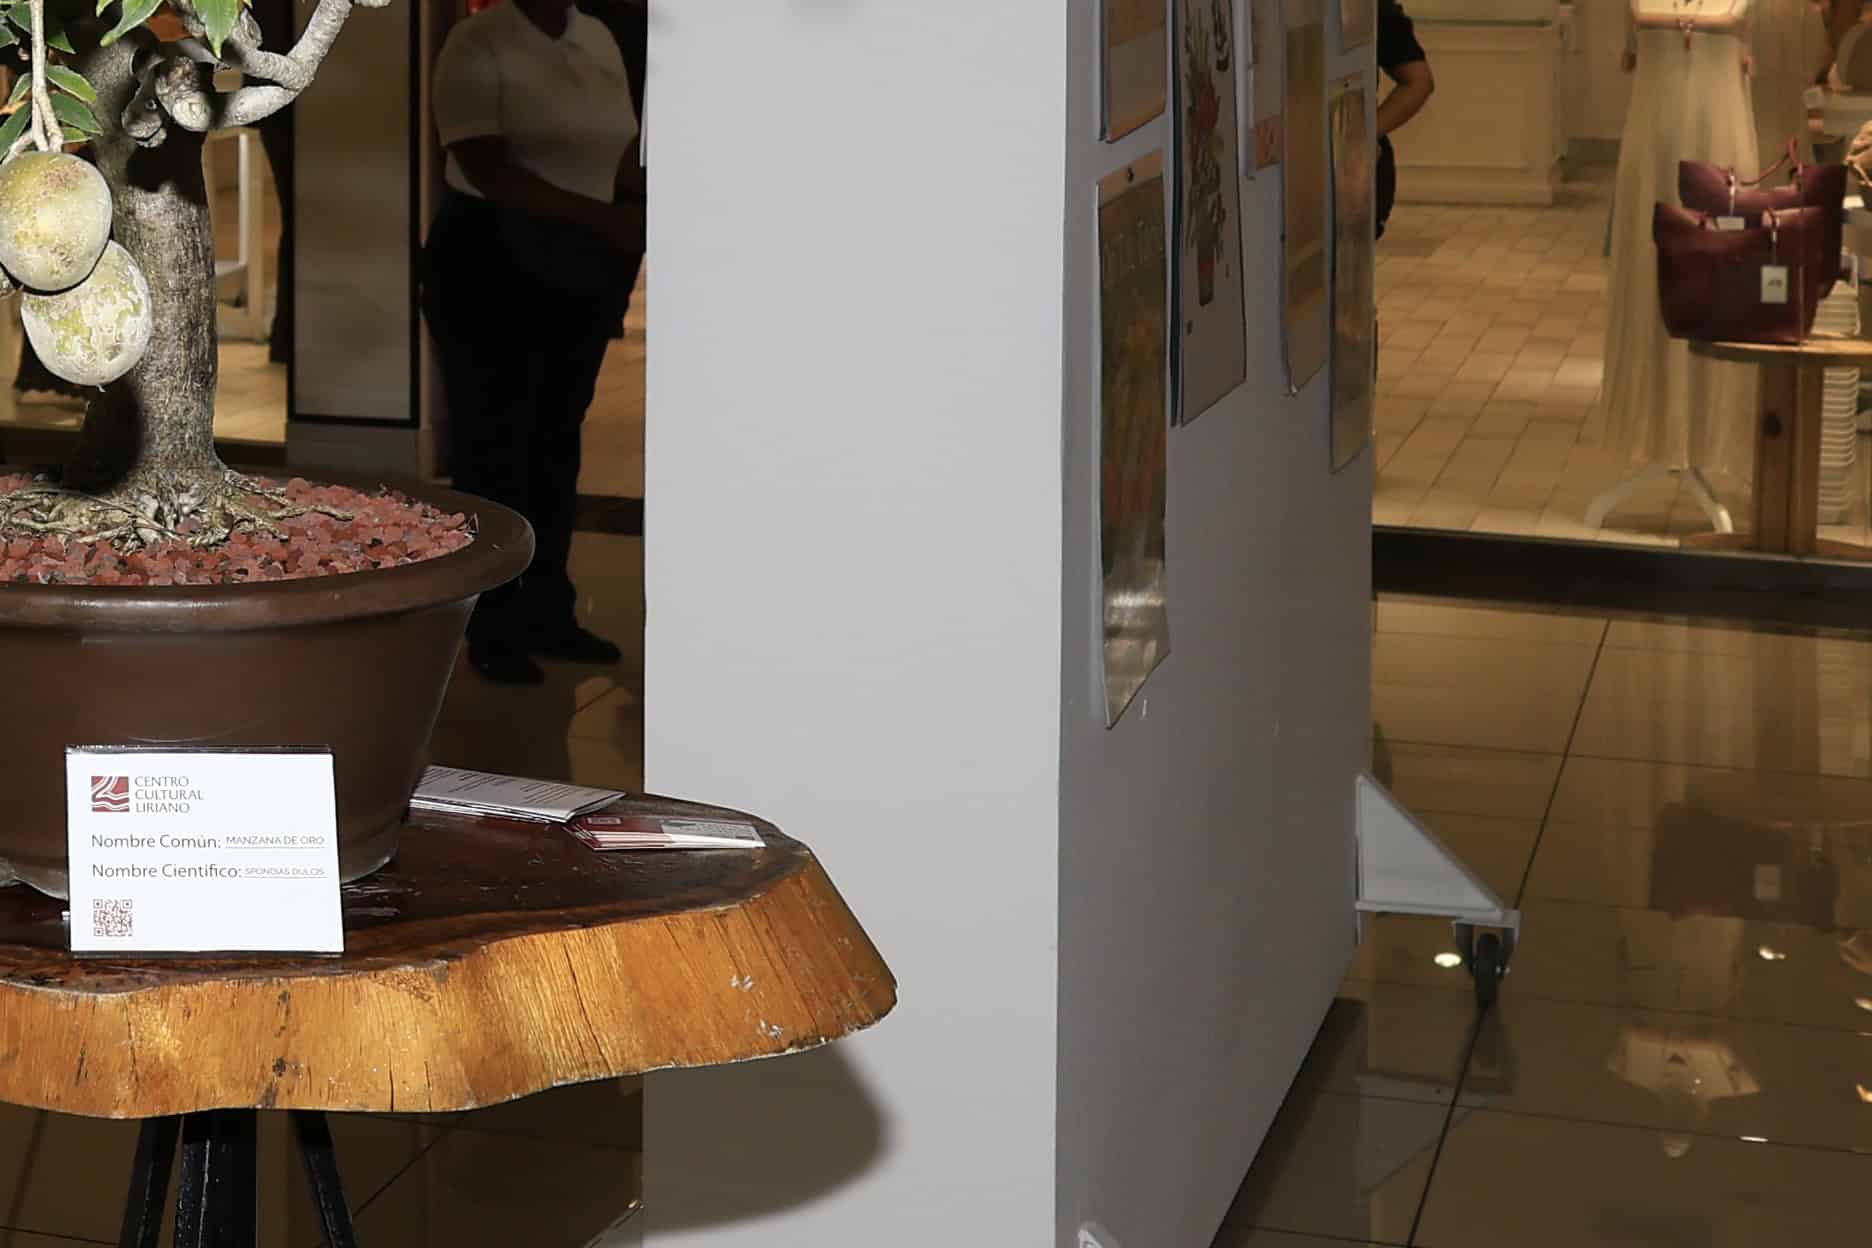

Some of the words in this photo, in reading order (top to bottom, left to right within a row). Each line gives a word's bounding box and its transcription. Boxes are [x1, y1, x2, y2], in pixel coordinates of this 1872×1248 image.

[134, 775, 189, 787] CENTRO
[134, 789, 204, 800] CULTURAL
[135, 802, 190, 813] LIRIANO
[91, 834, 156, 848] Nombre
[159, 834, 221, 848] Común:
[226, 835, 282, 845] MANZANA
[283, 835, 297, 845] DE
[299, 835, 325, 845] ORO
[92, 864, 157, 878] Nombre
